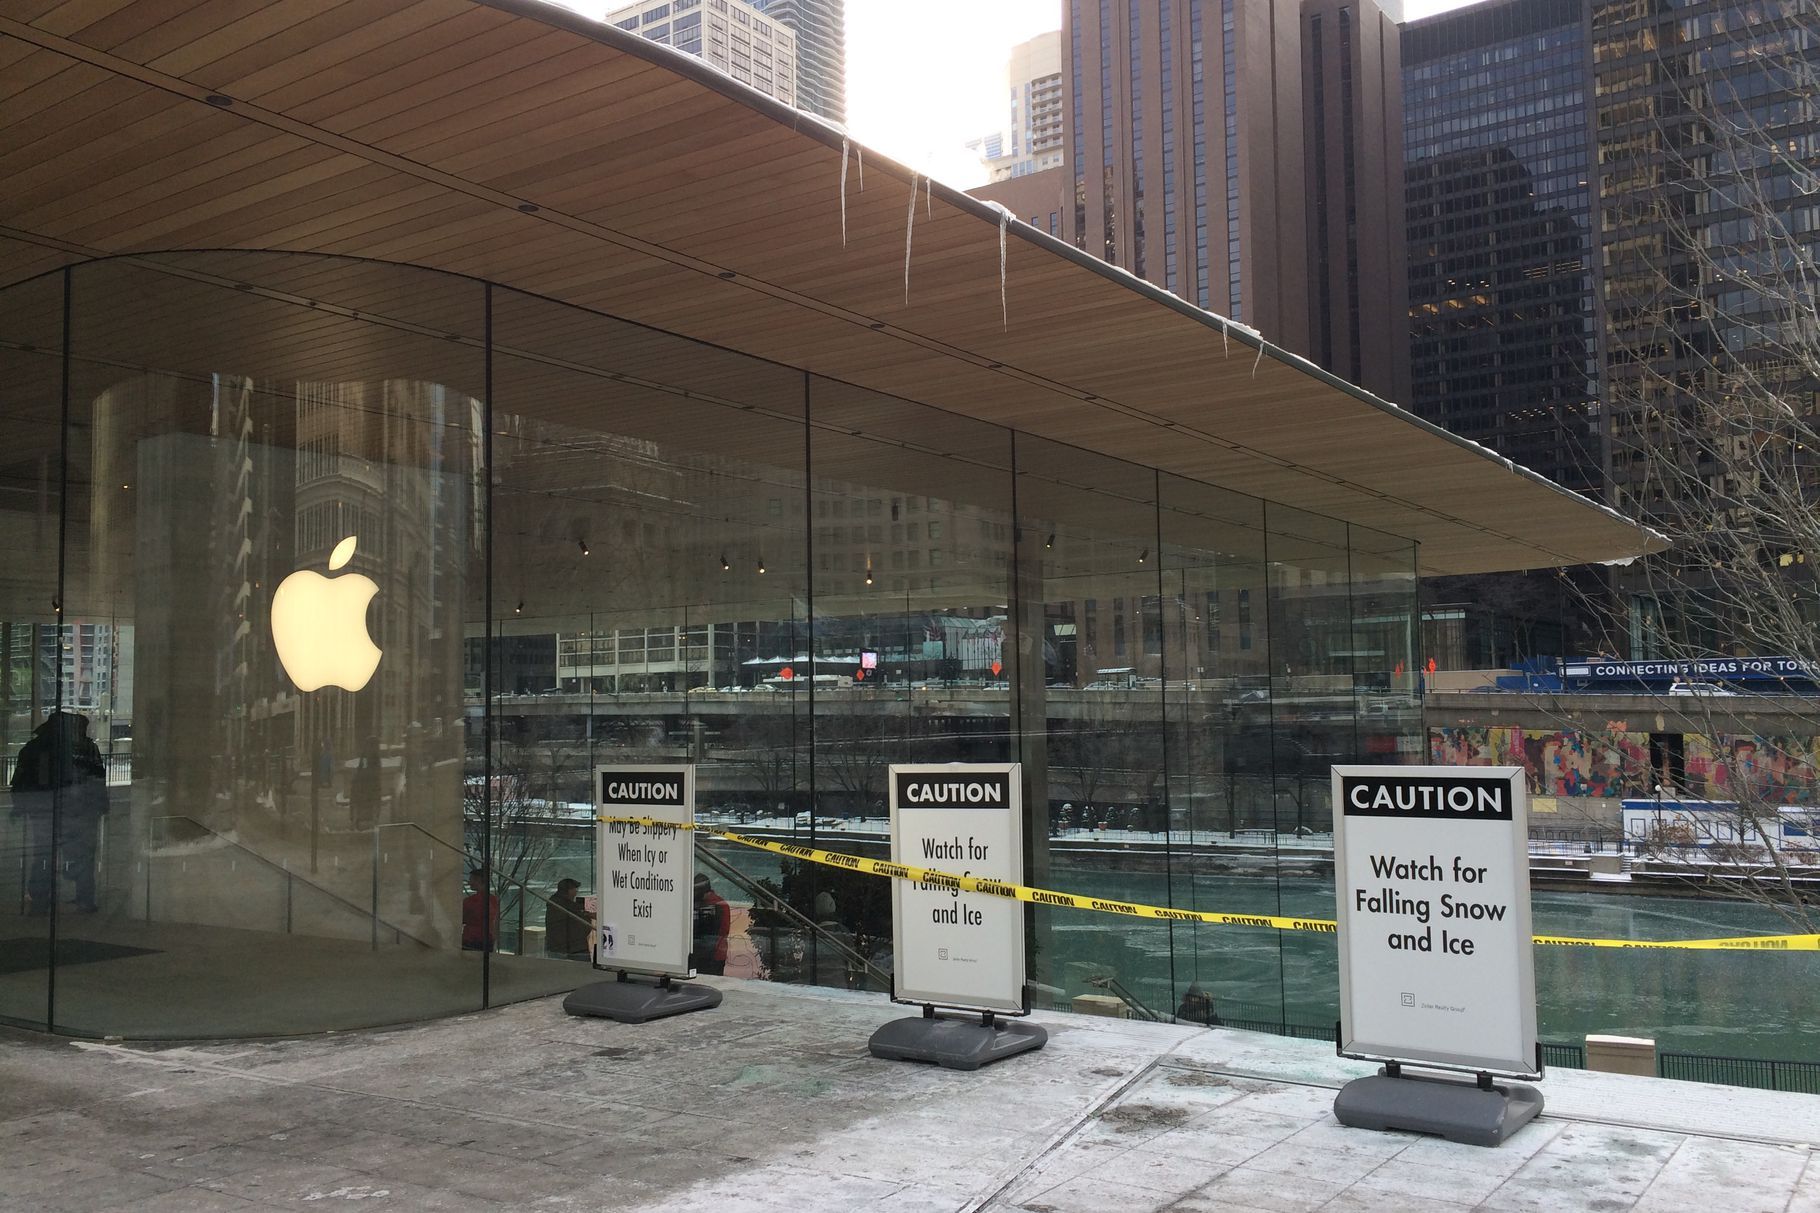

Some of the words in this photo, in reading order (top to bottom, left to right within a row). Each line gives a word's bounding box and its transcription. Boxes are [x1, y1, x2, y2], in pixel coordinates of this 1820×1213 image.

[1596, 664, 1688, 676] CONNECTING
[1694, 662, 1737, 673] IDEAS
[1742, 661, 1772, 672] FOR
[609, 782, 678, 800] CAUTION
[907, 783, 1001, 802] CAUTION
[1350, 785, 1502, 813] CAUTION
[618, 842, 641, 862] When
[645, 844, 656, 867] Icy
[659, 850, 668, 863] or
[922, 837, 962, 860] Watch
[968, 837, 989, 861] for
[612, 870, 628, 888] Wet
[630, 870, 674, 892] Conditions
[1370, 855, 1444, 881] Watch
[1453, 856, 1488, 883] for
[780, 843, 815, 858] CAUTION
[825, 853, 860, 868] CAUTION
[872, 862, 909, 878] CAUTION
[923, 872, 961, 888] CAUTION
[976, 882, 1017, 898] CAUTION
[1032, 892, 1075, 906] CAUTION
[1092, 901, 1138, 914] CAUTION
[1155, 910, 1203, 921] CAUTION
[1222, 916, 1273, 927] CAUTION
[1293, 921, 1337, 932] CAUTIO
[633, 898, 653, 918] Exist
[932, 900, 958, 924] and
[964, 904, 983, 925] Ice
[1356, 888, 1430, 924] Falling
[1441, 894, 1507, 921] Snow
[1388, 926, 1432, 952] and
[1442, 930, 1475, 956] Ice
